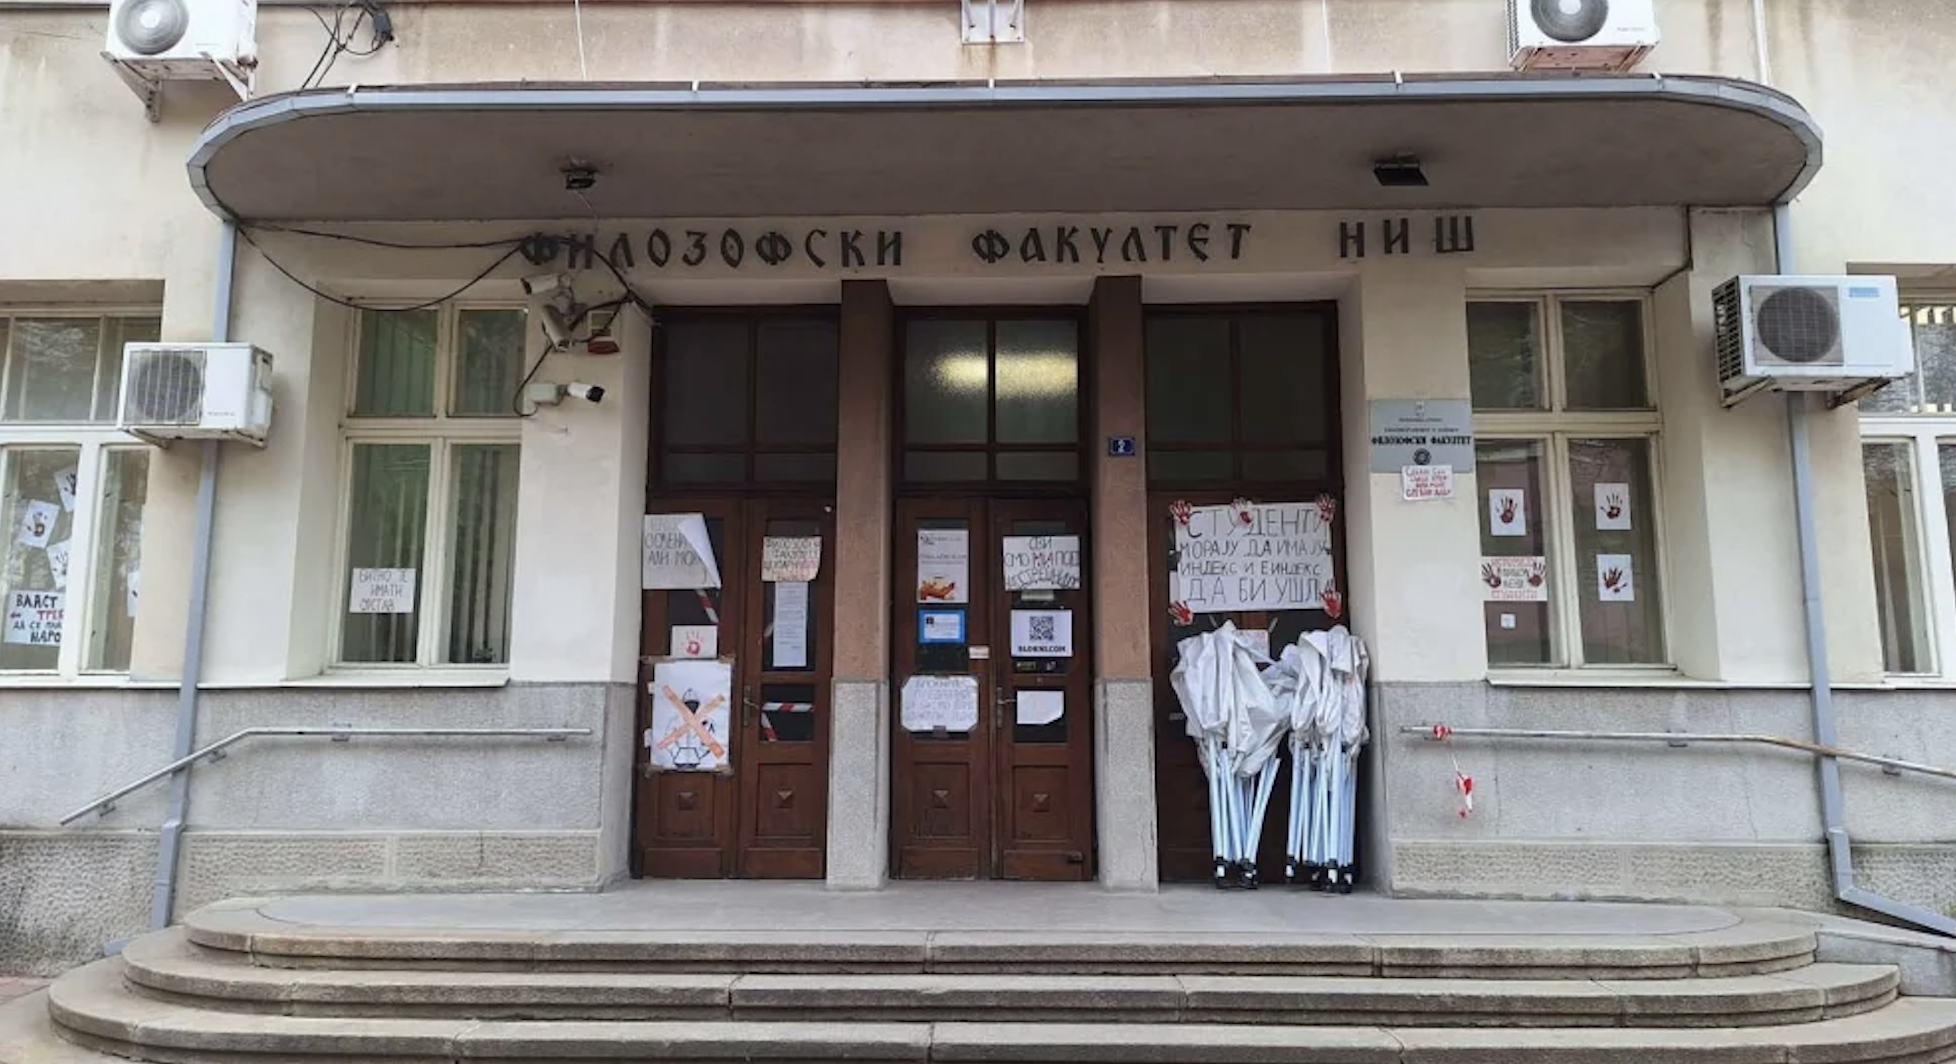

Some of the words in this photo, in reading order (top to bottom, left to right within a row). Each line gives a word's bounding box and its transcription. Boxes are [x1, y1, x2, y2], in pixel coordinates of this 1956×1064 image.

[519, 228, 901, 270] ФИЛОЗОФСКИ
[972, 222, 1251, 263] ФАКУЛТЕТ
[1340, 216, 1475, 258] НИШ
[1180, 540, 1239, 559] МОРАЈУ
[1243, 539, 1272, 557] ДА
[1277, 540, 1328, 558] ИМАЈУ
[1181, 561, 1238, 576] ИНДЕКС
[1245, 562, 1255, 574] И
[1261, 561, 1322, 577] ЕИНДЕКС
[1187, 577, 1227, 604] ДА
[1239, 577, 1267, 604] БИ
[1274, 578, 1325, 604] УШЛ
[16, 594, 58, 609] ВЛАСТ
